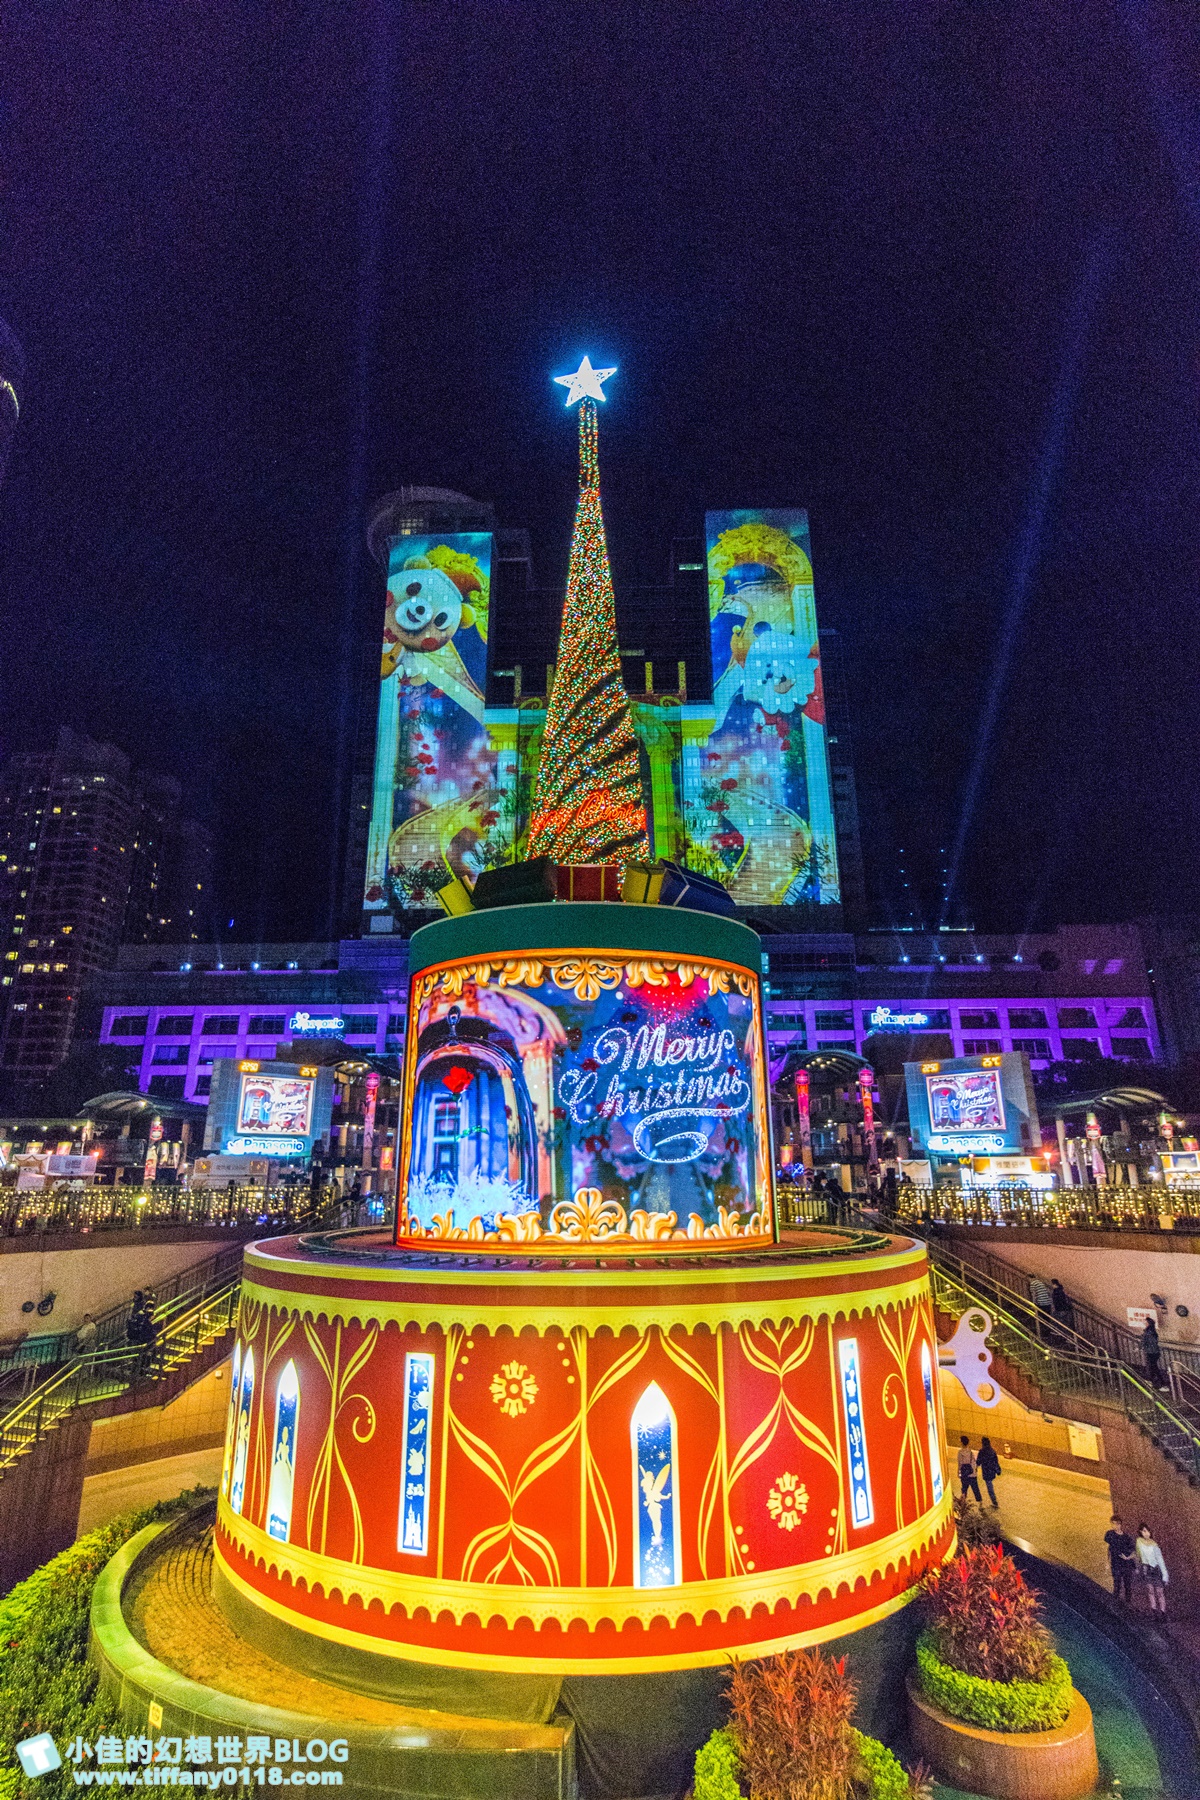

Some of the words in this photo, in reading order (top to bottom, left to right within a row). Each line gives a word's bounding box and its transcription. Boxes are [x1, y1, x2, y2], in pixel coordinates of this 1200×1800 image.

[593, 1023, 735, 1072] Merry
[558, 1069, 751, 1163] Christmas
[243, 1138, 304, 1151] Panasonic
[941, 1136, 1004, 1148] Panasonic
